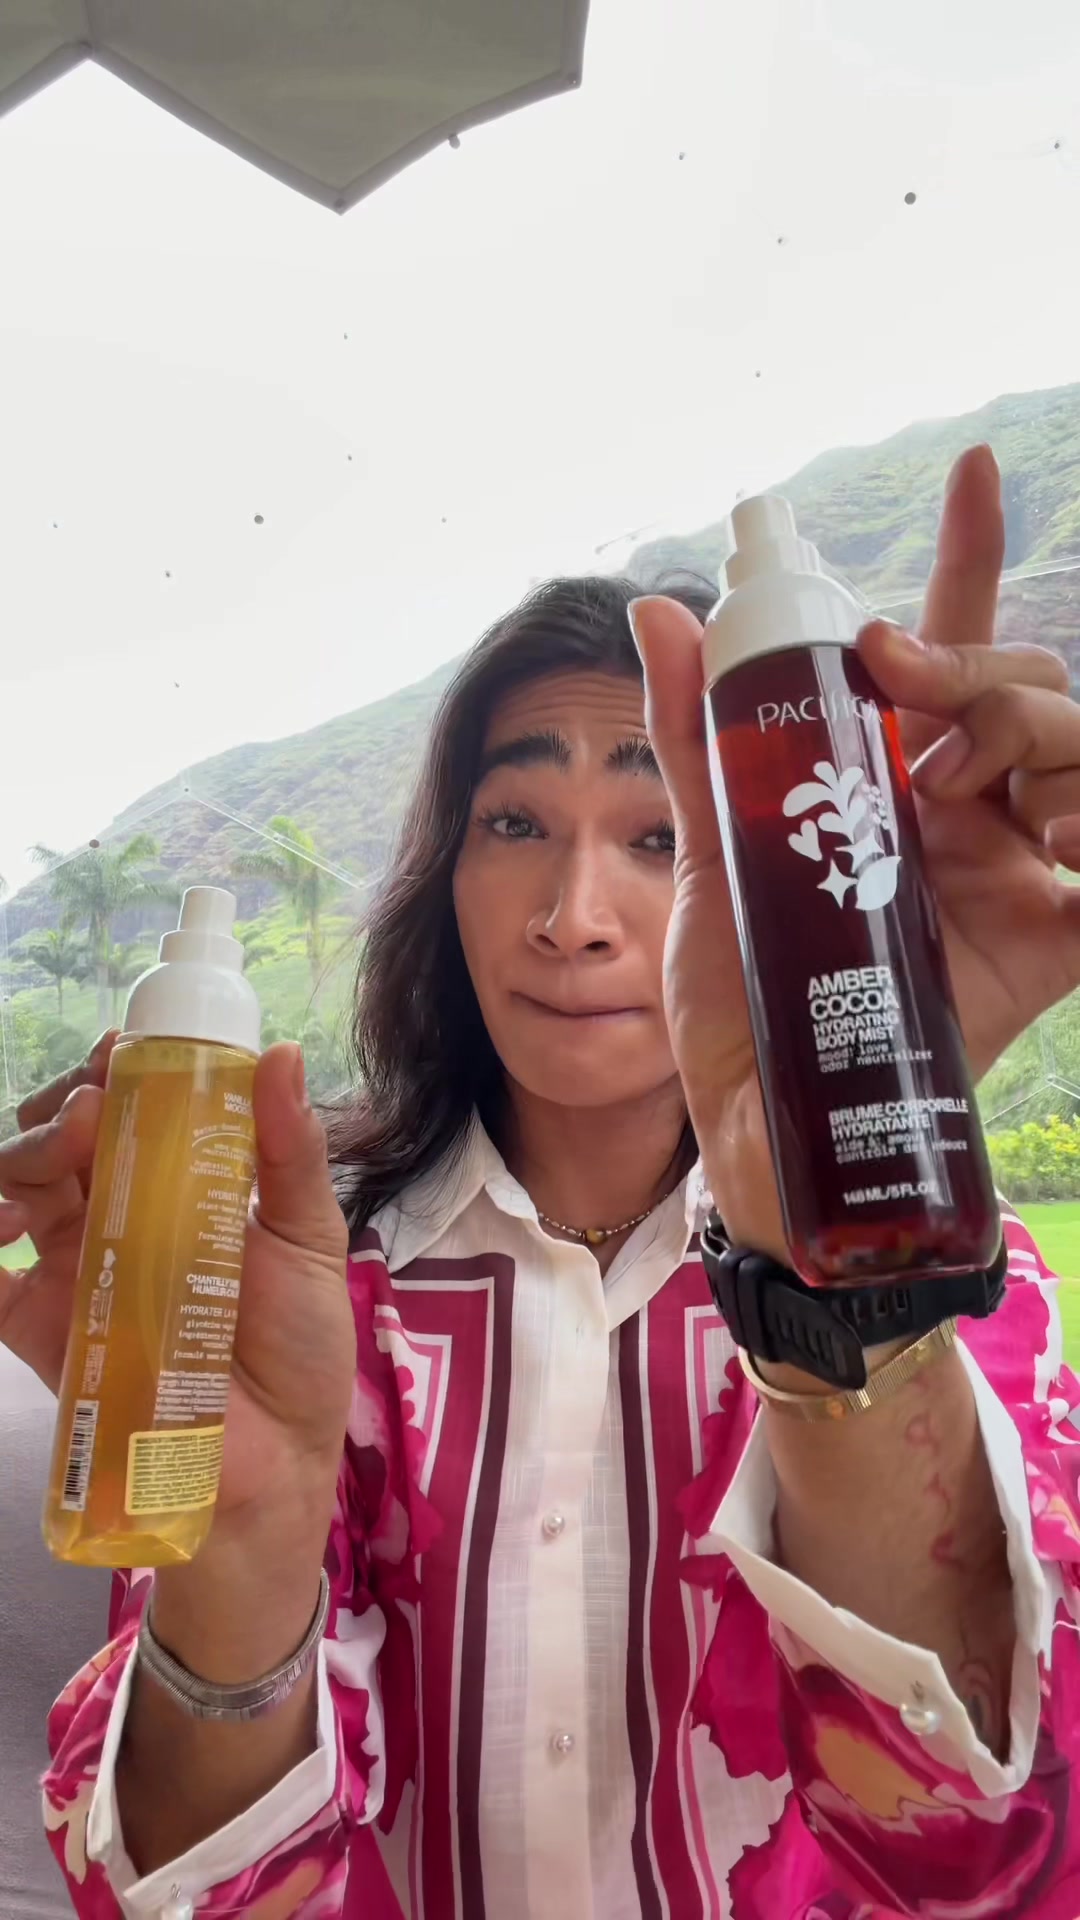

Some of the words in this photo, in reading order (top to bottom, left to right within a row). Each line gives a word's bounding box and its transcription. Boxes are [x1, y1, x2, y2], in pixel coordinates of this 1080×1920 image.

[808, 966, 894, 1000] AMBER
[810, 989, 900, 1021] COCOA
[813, 1011, 900, 1038] HYDRATING
[816, 1031, 858, 1052] BODY
[857, 1026, 895, 1043] MIST
[859, 1043, 889, 1056] love
[829, 1102, 884, 1126] BRUME
[885, 1098, 969, 1116] CORPORELLE
[831, 1114, 931, 1141] HYDRATANTE
